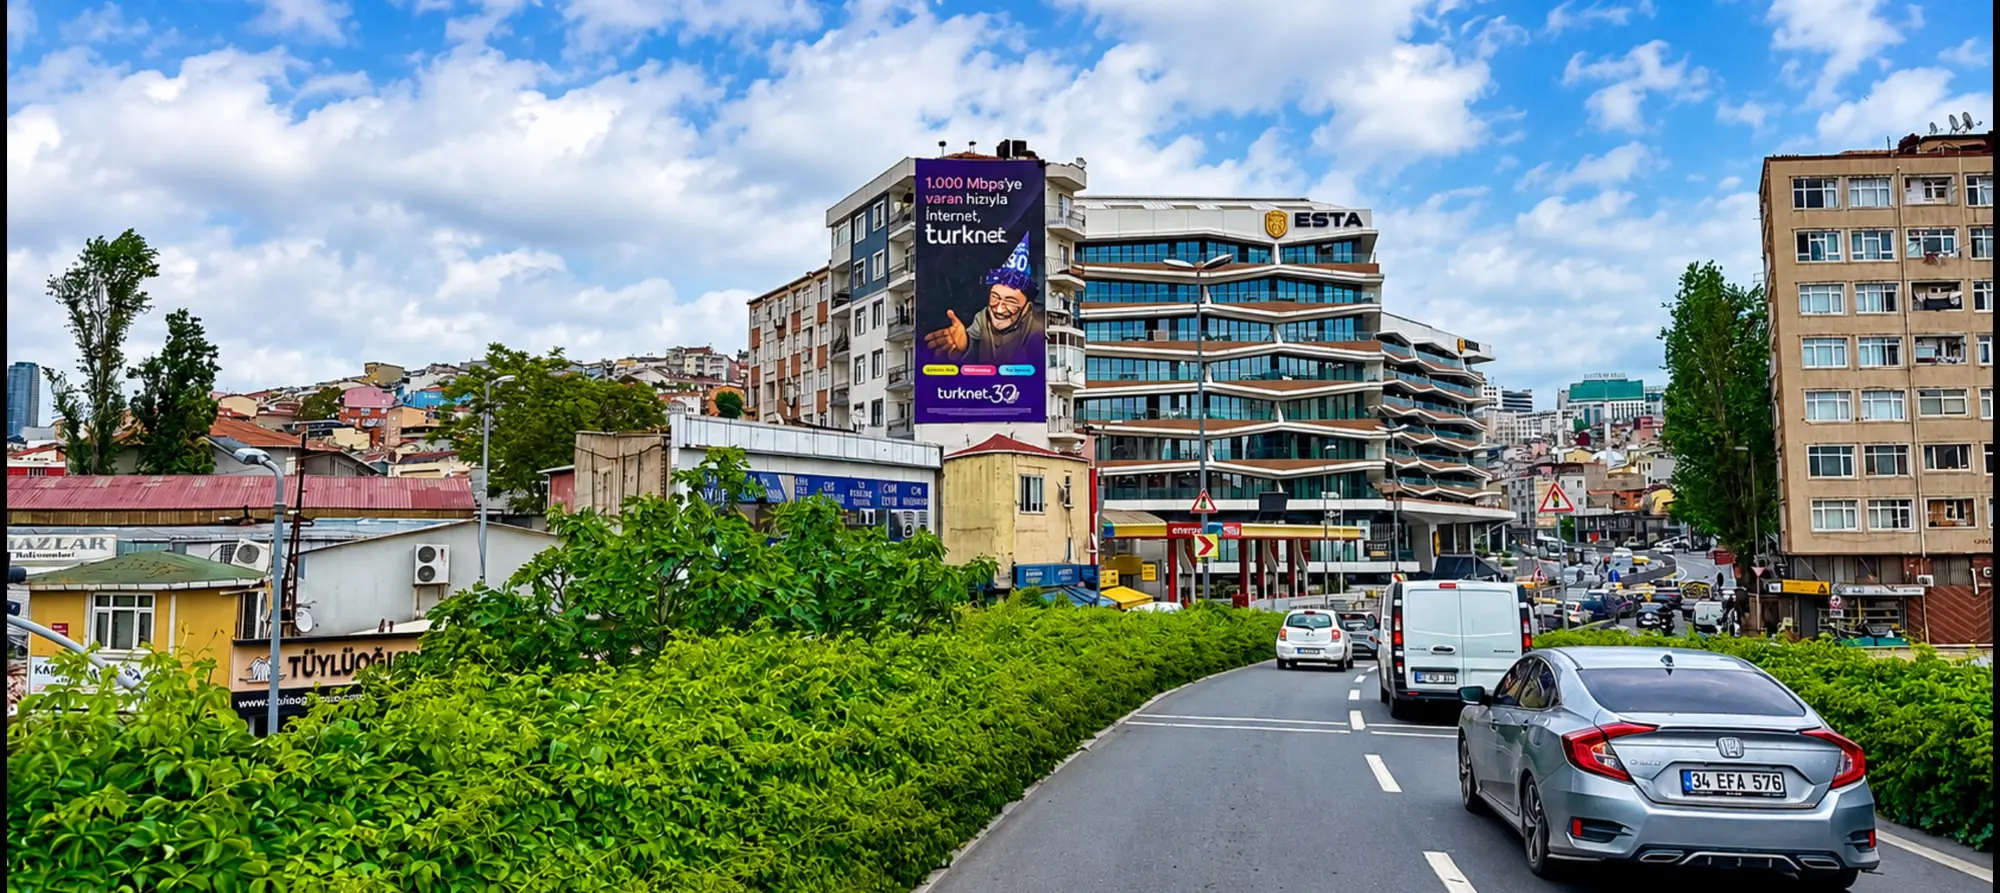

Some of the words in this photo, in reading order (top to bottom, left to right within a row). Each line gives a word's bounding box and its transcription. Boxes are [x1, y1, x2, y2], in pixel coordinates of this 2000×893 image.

[925, 176, 963, 189] 1.000
[966, 177, 1022, 192] Mbps'ye
[925, 194, 963, 205] varan
[1294, 212, 1363, 227] ESTA
[925, 223, 1007, 244] turknet
[937, 386, 990, 400] turknet
[1691, 772, 1710, 789] 34
[1717, 773, 1746, 790] EFA
[1753, 774, 1782, 791] 576
